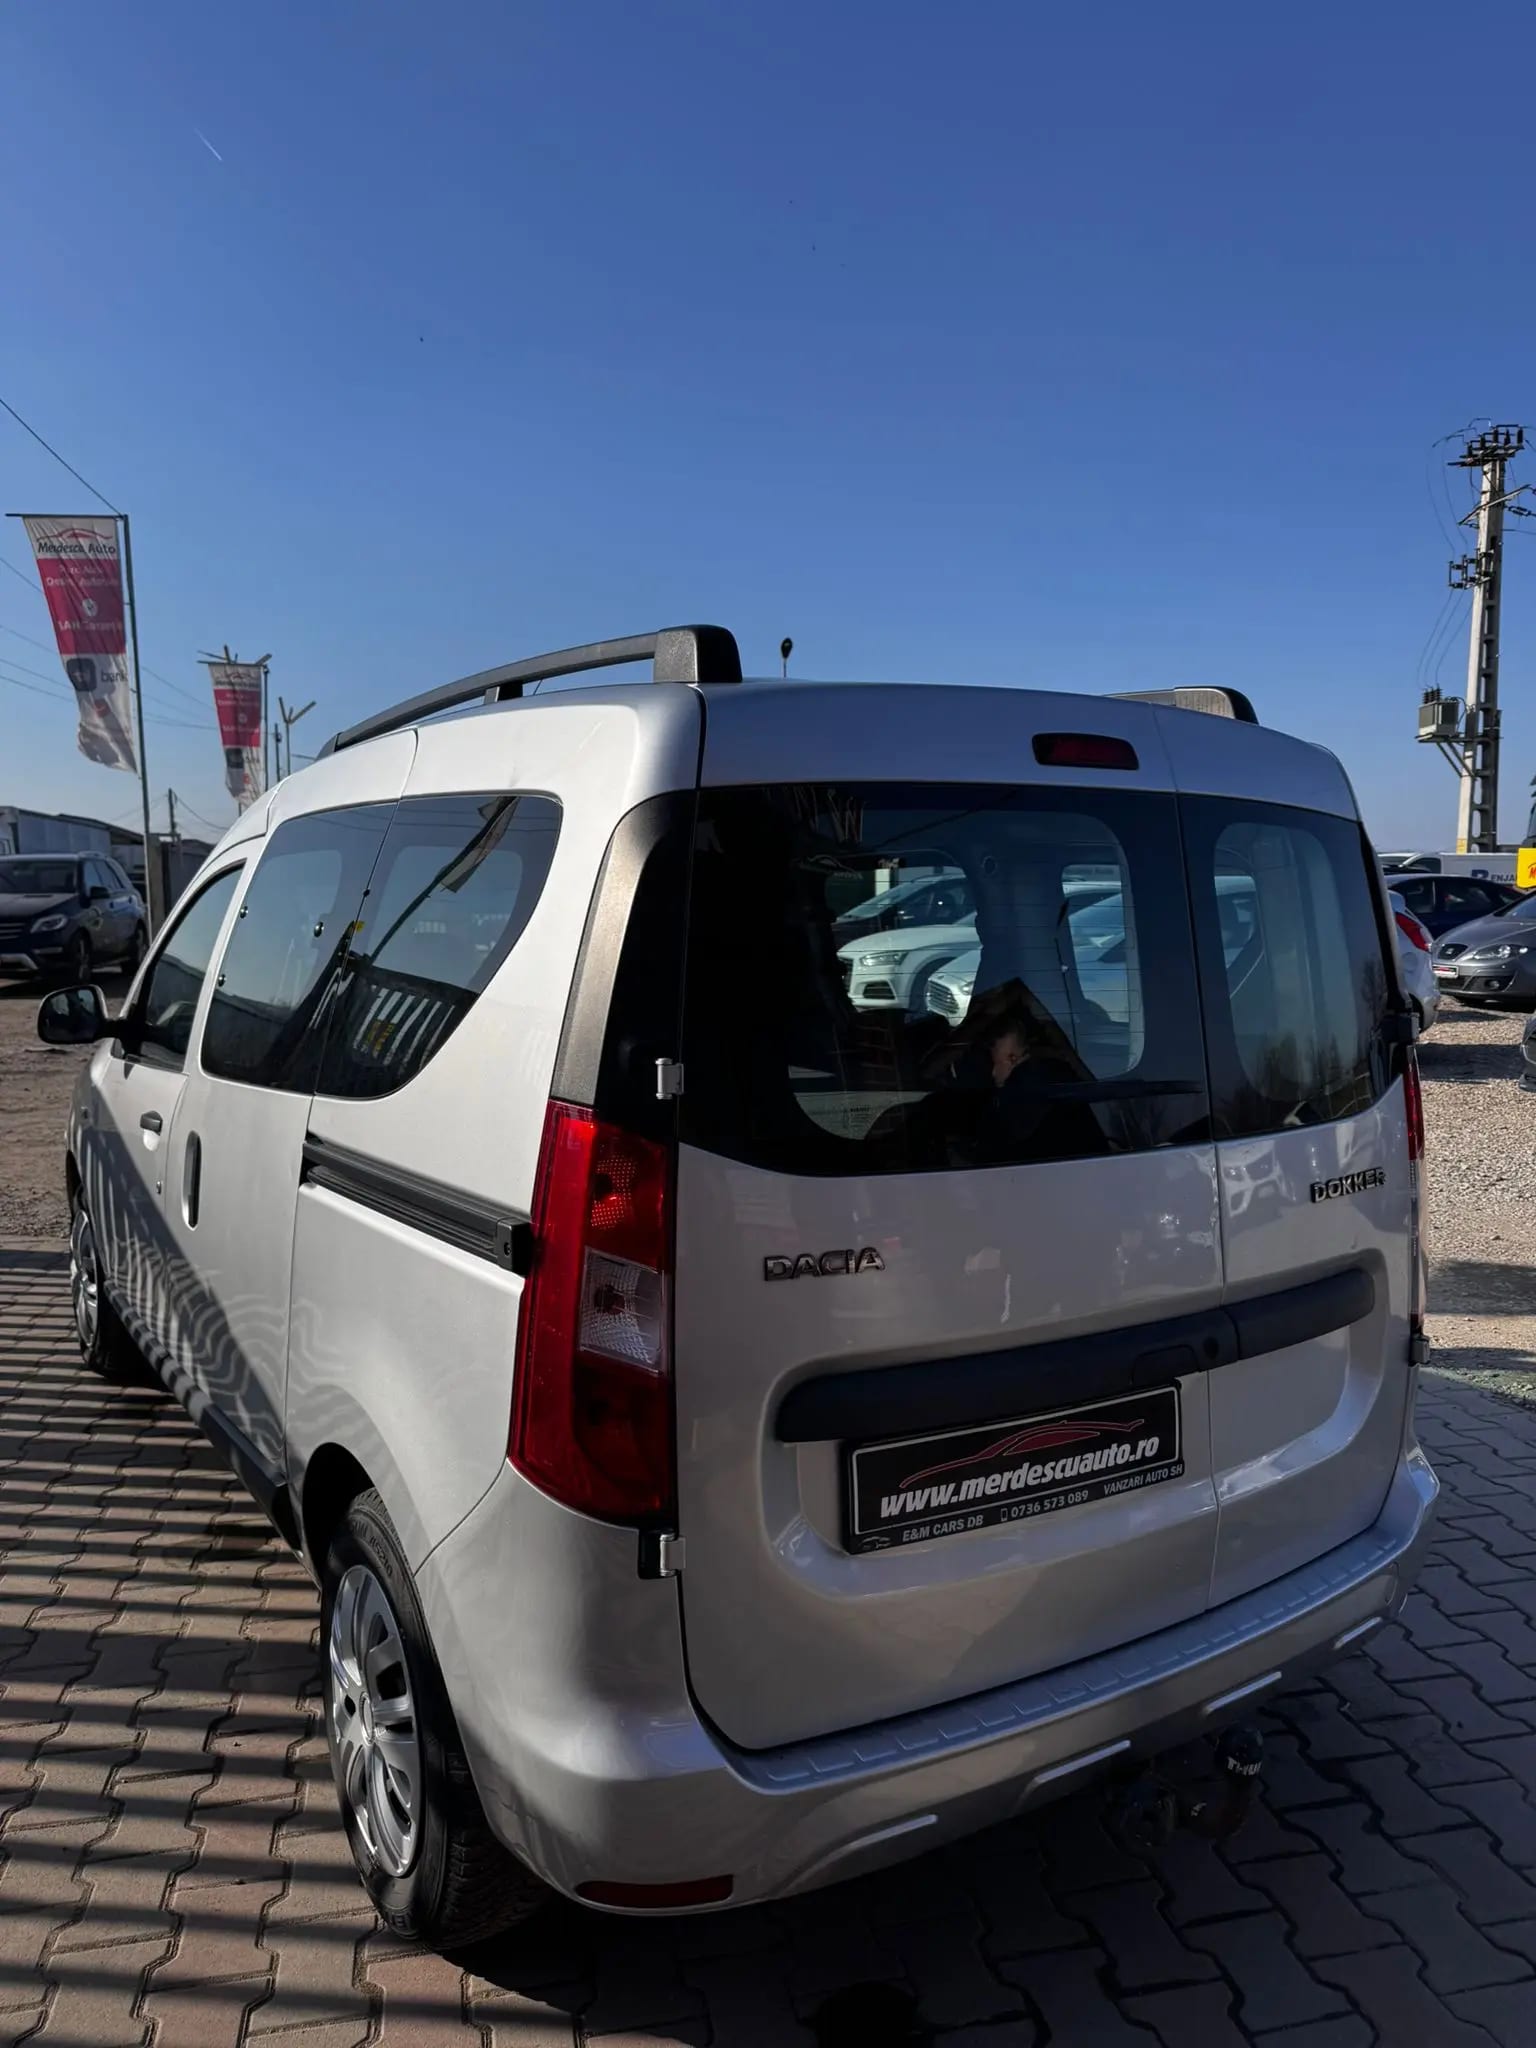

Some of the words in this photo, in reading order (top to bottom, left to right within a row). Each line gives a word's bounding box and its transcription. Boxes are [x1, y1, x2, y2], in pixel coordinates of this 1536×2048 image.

[88, 543, 116, 554] Auto
[1310, 1167, 1385, 1203] DOKKER
[764, 1247, 885, 1281] DACIA
[880, 1437, 1160, 1518] www.merdescuauto.ro
[902, 1526, 930, 1542] E&M
[932, 1519, 964, 1535] CARS
[967, 1514, 984, 1528] DB
[1011, 1502, 1041, 1518] 0736
[1043, 1495, 1065, 1511] 573
[1069, 1490, 1089, 1504] 089
[1104, 1475, 1144, 1495] VANZARI
[1145, 1468, 1169, 1484] AUTO
[1170, 1464, 1183, 1477] SH
